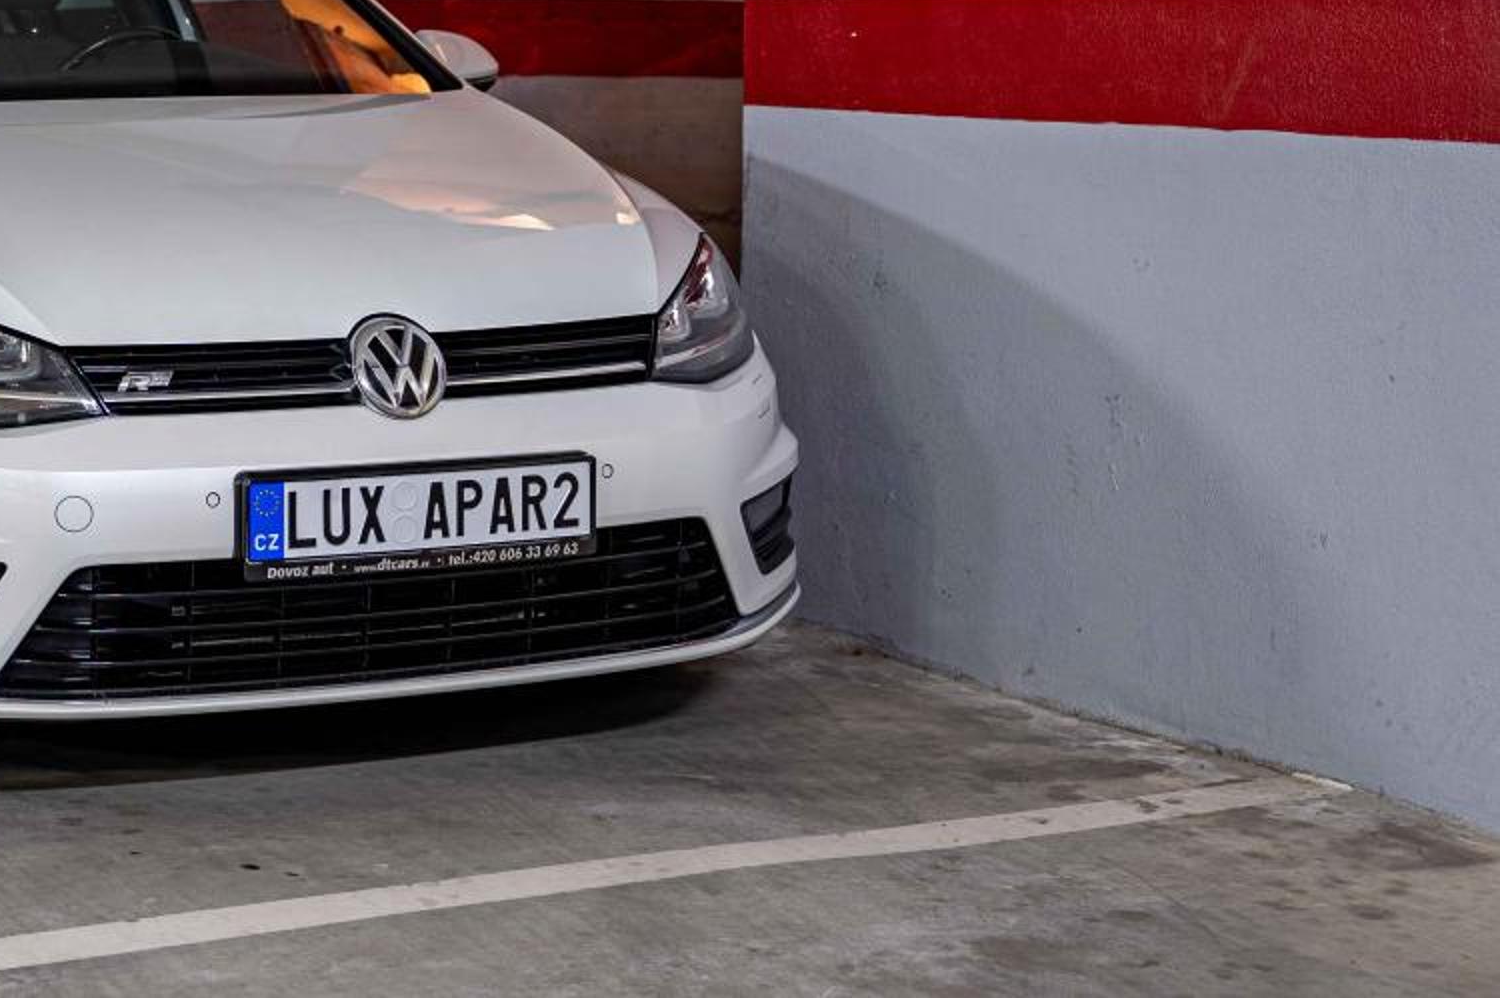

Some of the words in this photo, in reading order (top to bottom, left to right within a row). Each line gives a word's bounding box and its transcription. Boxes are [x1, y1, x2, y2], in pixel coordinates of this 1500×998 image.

[287, 484, 386, 549] LUX
[423, 471, 580, 540] APAR2
[254, 533, 280, 552] CZ
[267, 566, 309, 579] Dovoz
[499, 547, 523, 561] 606
[525, 545, 542, 559] 33
[545, 543, 562, 557] 69
[563, 541, 580, 555] 63
